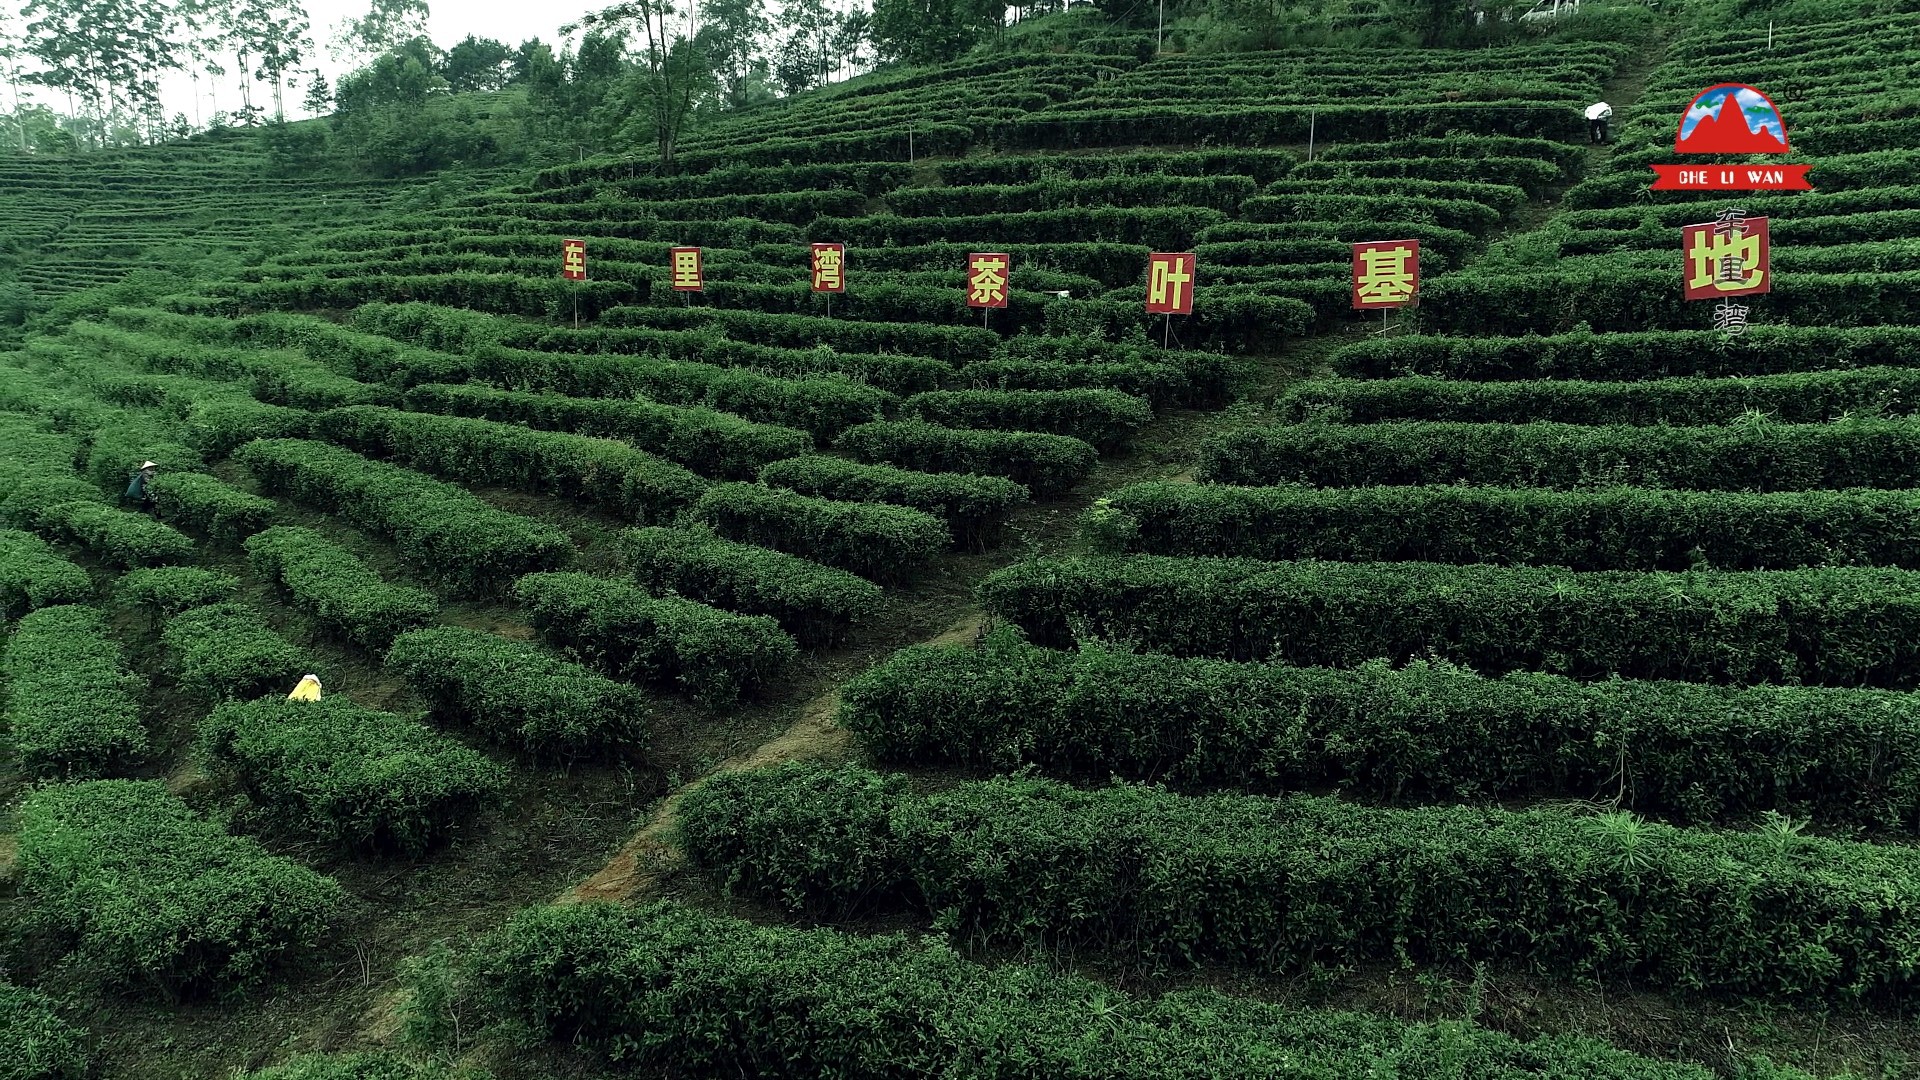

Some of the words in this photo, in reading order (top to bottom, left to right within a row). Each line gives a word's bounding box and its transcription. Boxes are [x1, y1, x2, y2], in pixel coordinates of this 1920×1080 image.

[566, 243, 584, 277] 车
[675, 252, 700, 287] 里
[814, 248, 841, 288] 湾
[970, 257, 1005, 304] 茶
[1150, 258, 1189, 309] 叶
[1358, 247, 1414, 303] 基
[1689, 230, 1764, 291] 地
